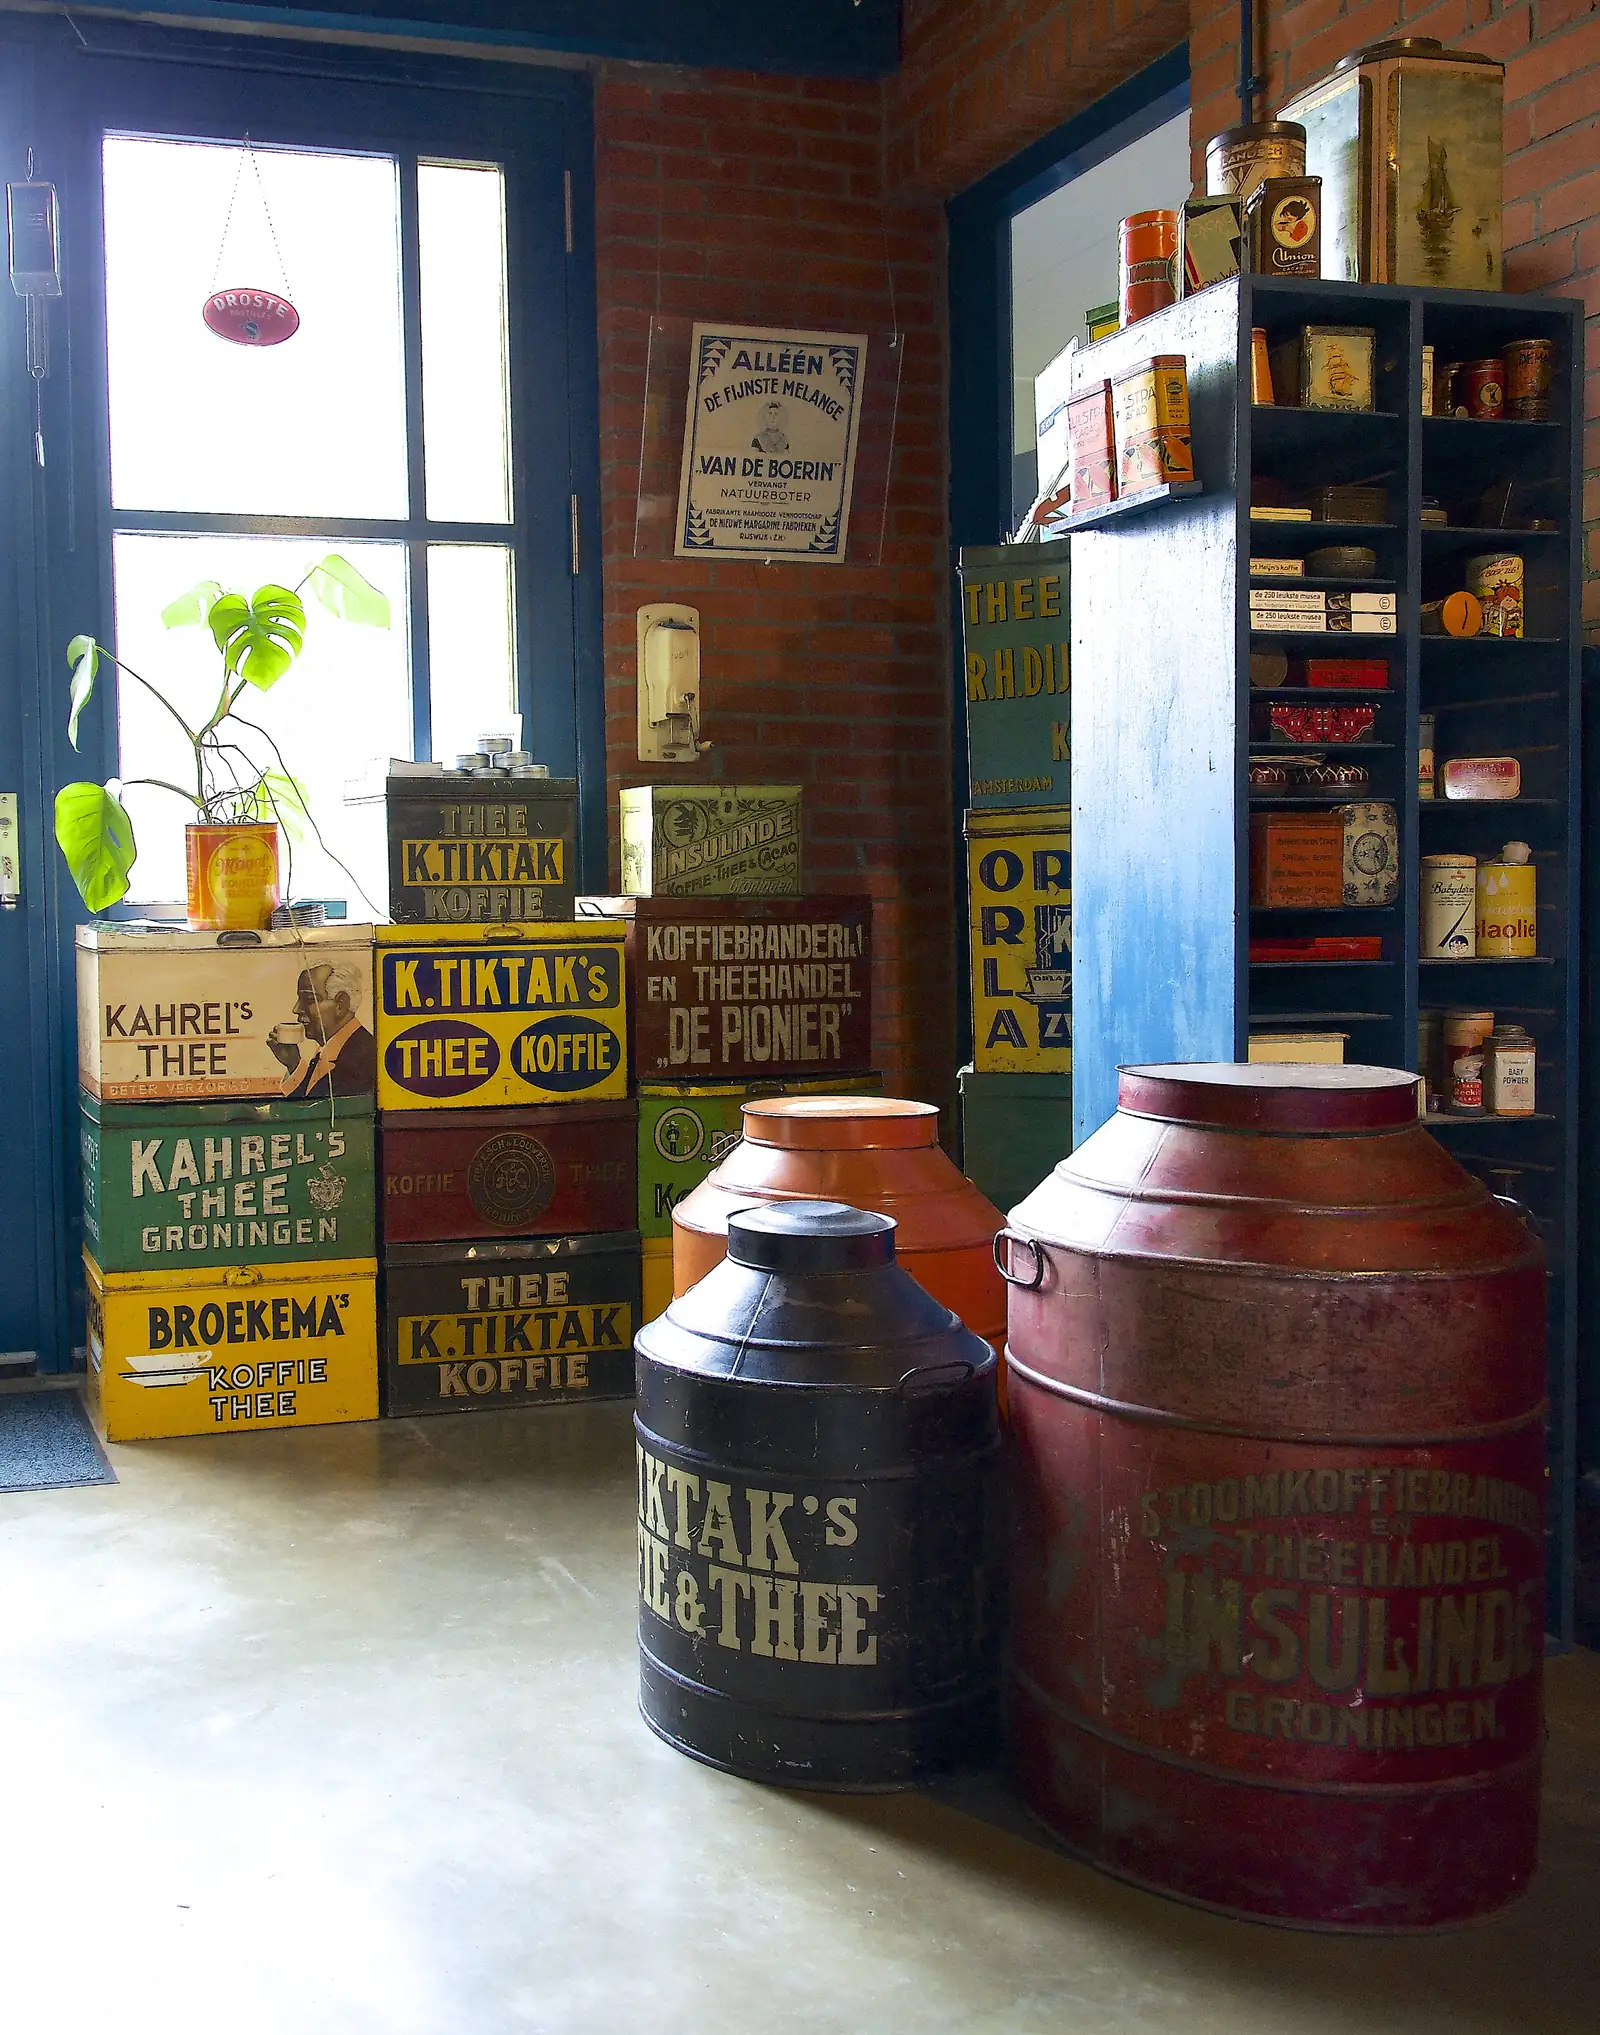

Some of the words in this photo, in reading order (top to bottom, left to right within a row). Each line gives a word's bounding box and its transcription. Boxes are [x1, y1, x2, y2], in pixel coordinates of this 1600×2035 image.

[1272, 247, 1317, 268] Union
[213, 293, 288, 319] DROSTE
[731, 348, 823, 375] ALLÉÉN
[704, 391, 723, 413] DE
[724, 378, 778, 403] FIJNSTE
[783, 379, 845, 421] MELANGE
[742, 458, 764, 477] DE
[720, 488, 812, 502] NATUURBOTER
[748, 481, 788, 489] VERVANGT
[709, 518, 719, 528] DE
[719, 519, 742, 529] NIEUWE
[966, 576, 1061, 625] THEE
[1264, 591, 1276, 599] 250
[1276, 591, 1299, 600] leukste
[1301, 613, 1322, 621] musea
[973, 776, 1054, 796] AMSTERDAM
[440, 803, 528, 837] THEE
[661, 808, 793, 879] INSULINDE
[407, 842, 559, 882] K.TIKTAK
[728, 876, 793, 895] Groningen
[424, 887, 543, 919] KOFFIE
[647, 976, 677, 1002] EN
[692, 963, 861, 1001] THEEHANDEL
[1033, 974, 1063, 982] ORLA
[105, 1001, 253, 1037] KAHREL'S
[137, 1042, 227, 1077] THEE
[395, 1037, 489, 1079] THEE
[520, 1032, 611, 1073] KOFFIE
[1508, 1068, 1524, 1076] BABY
[131, 1131, 345, 1197] KAHREL'S
[569, 1161, 628, 1184] THEE
[178, 1174, 290, 1219] THEE
[386, 1173, 456, 1195] KOFFIE
[141, 1217, 338, 1252] GRONINGEN
[461, 1271, 570, 1311] THEE
[410, 1307, 624, 1359] K.TIKTAK
[209, 1358, 327, 1392] KOFFIE
[438, 1354, 588, 1397] KOFFIE
[209, 1390, 296, 1422] THEE
[1234, 1530, 1508, 1587] THEEHANDEL
[675, 1571, 706, 1638] &
[709, 1564, 878, 1666] THEE
